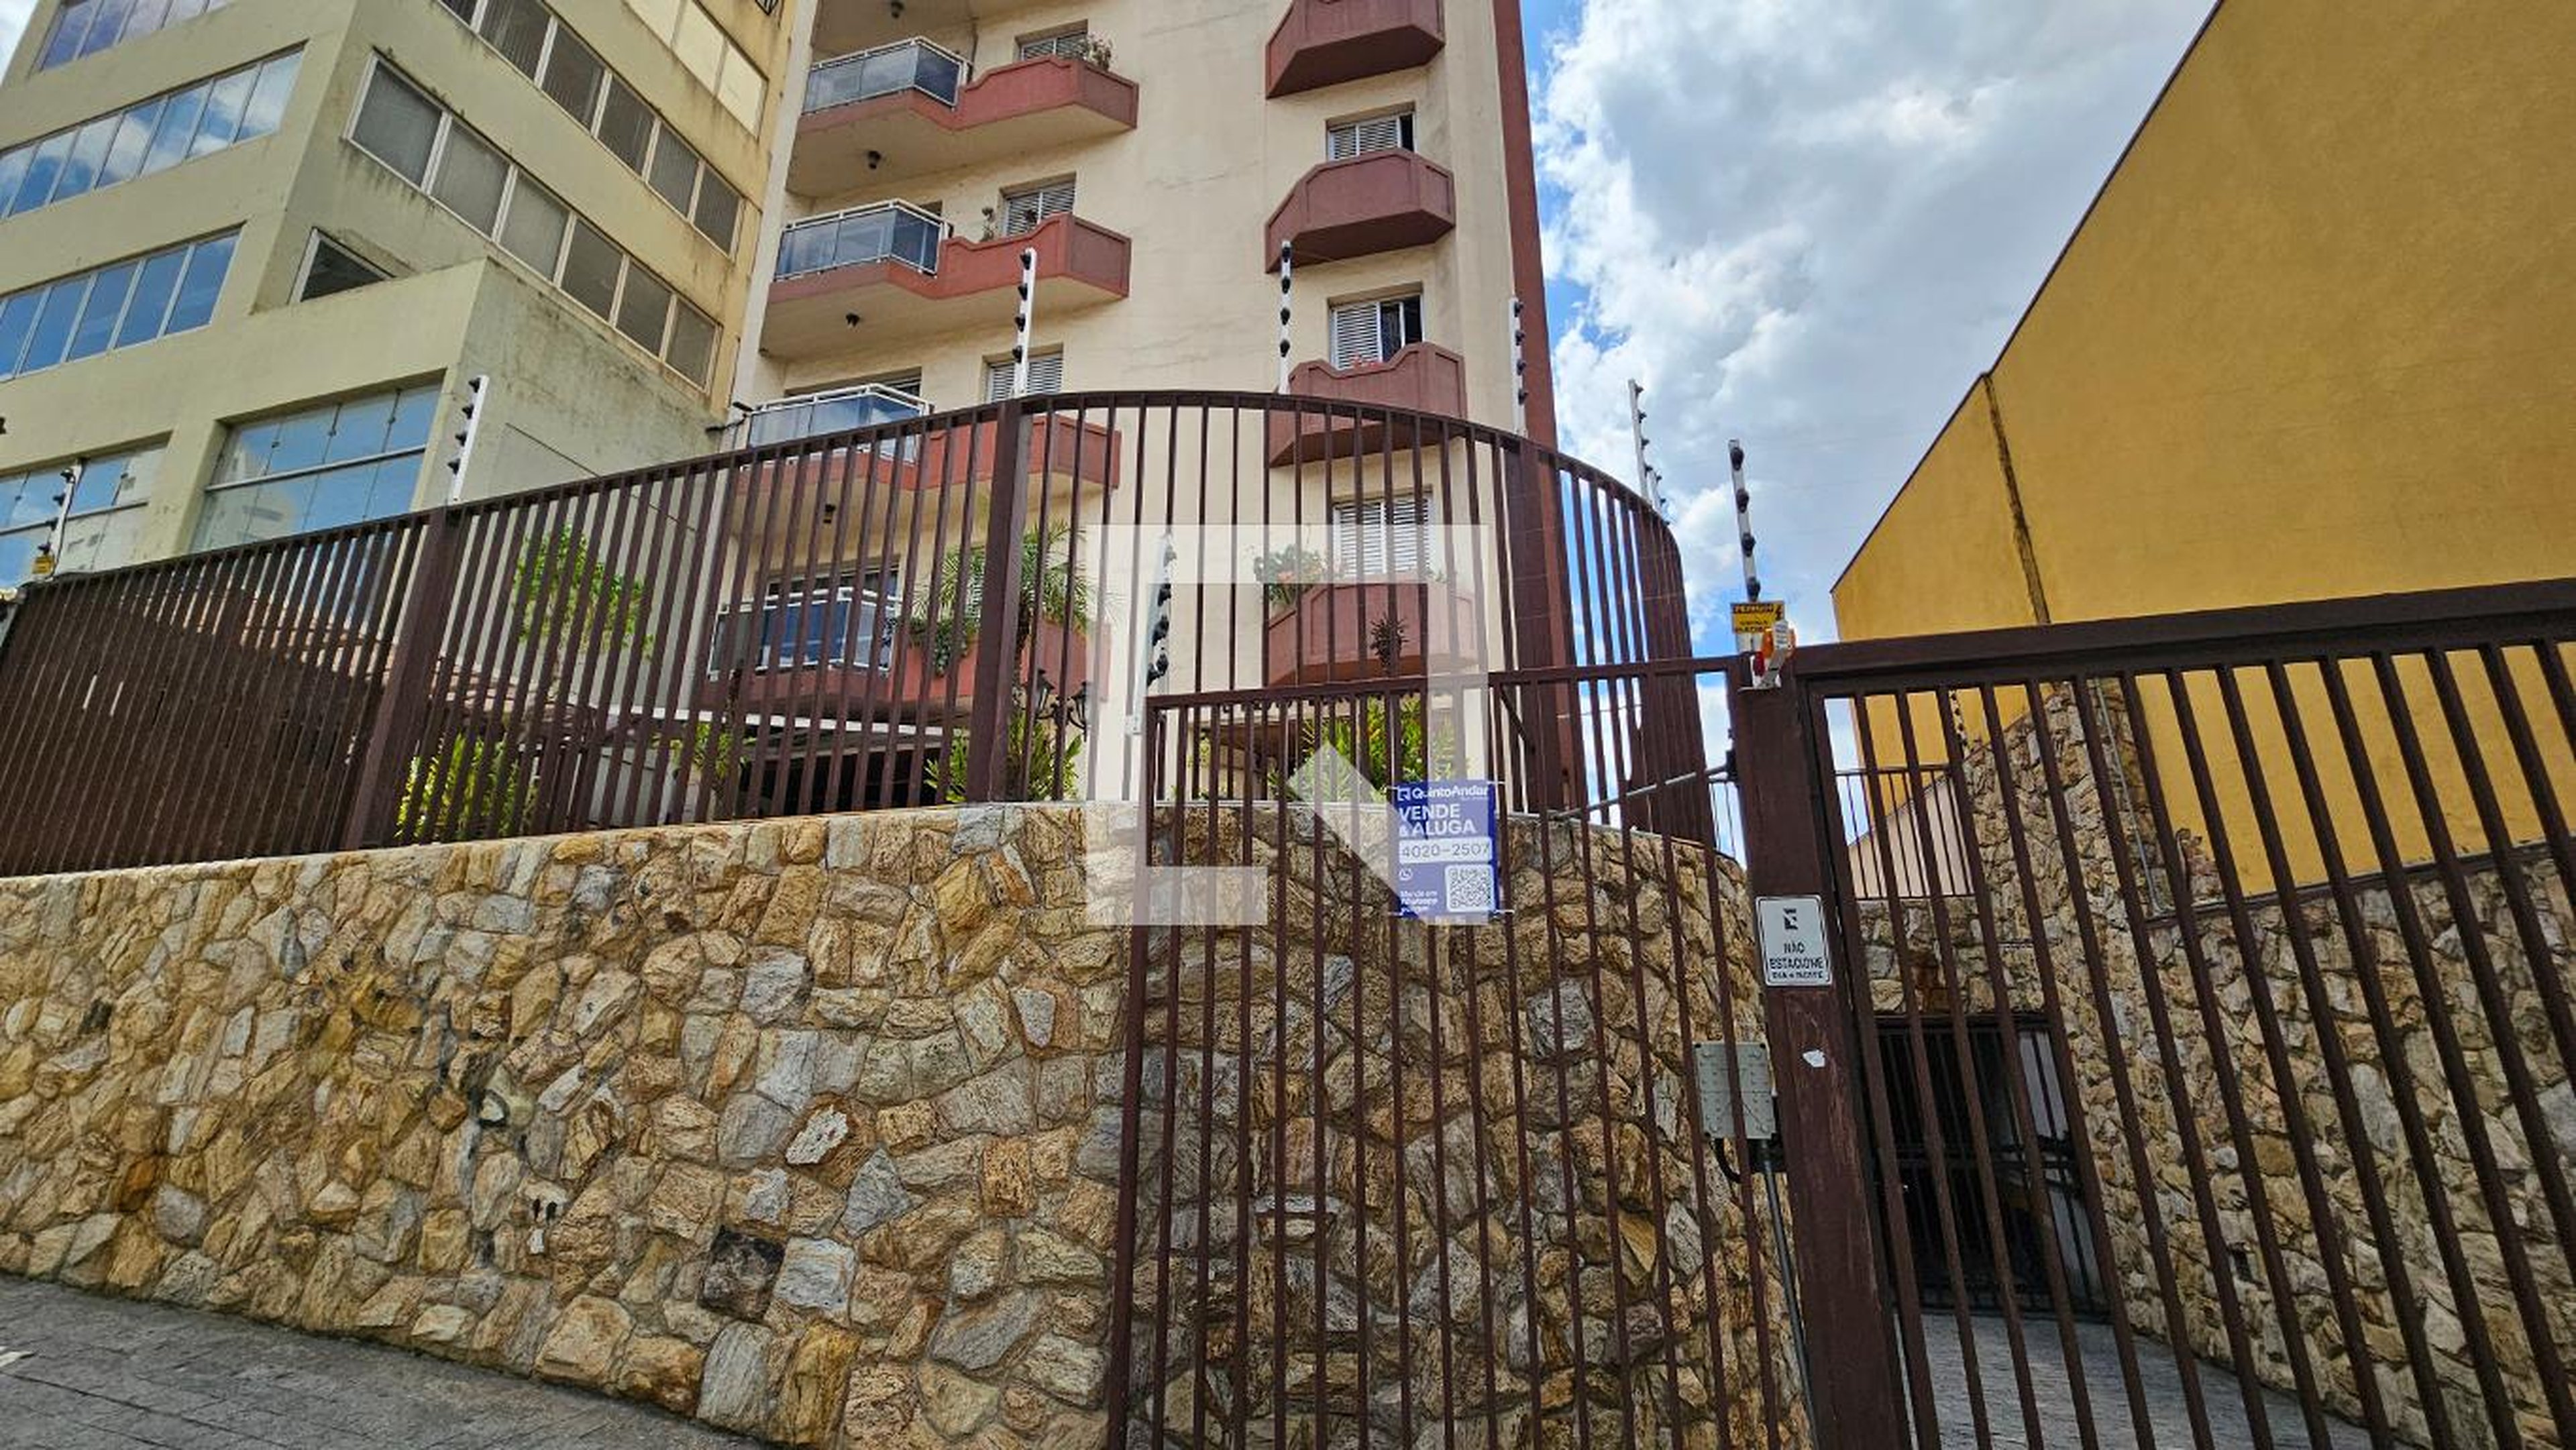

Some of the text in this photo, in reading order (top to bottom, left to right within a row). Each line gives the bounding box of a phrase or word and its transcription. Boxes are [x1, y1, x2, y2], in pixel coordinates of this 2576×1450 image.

[1412, 785, 1489, 799] QuintoAndar
[1399, 803, 1461, 822] VENDE
[1399, 818, 1478, 837] & ALUGA
[1402, 842, 1490, 858] 4020-2507
[1770, 956, 1824, 969] ESTACIONE
